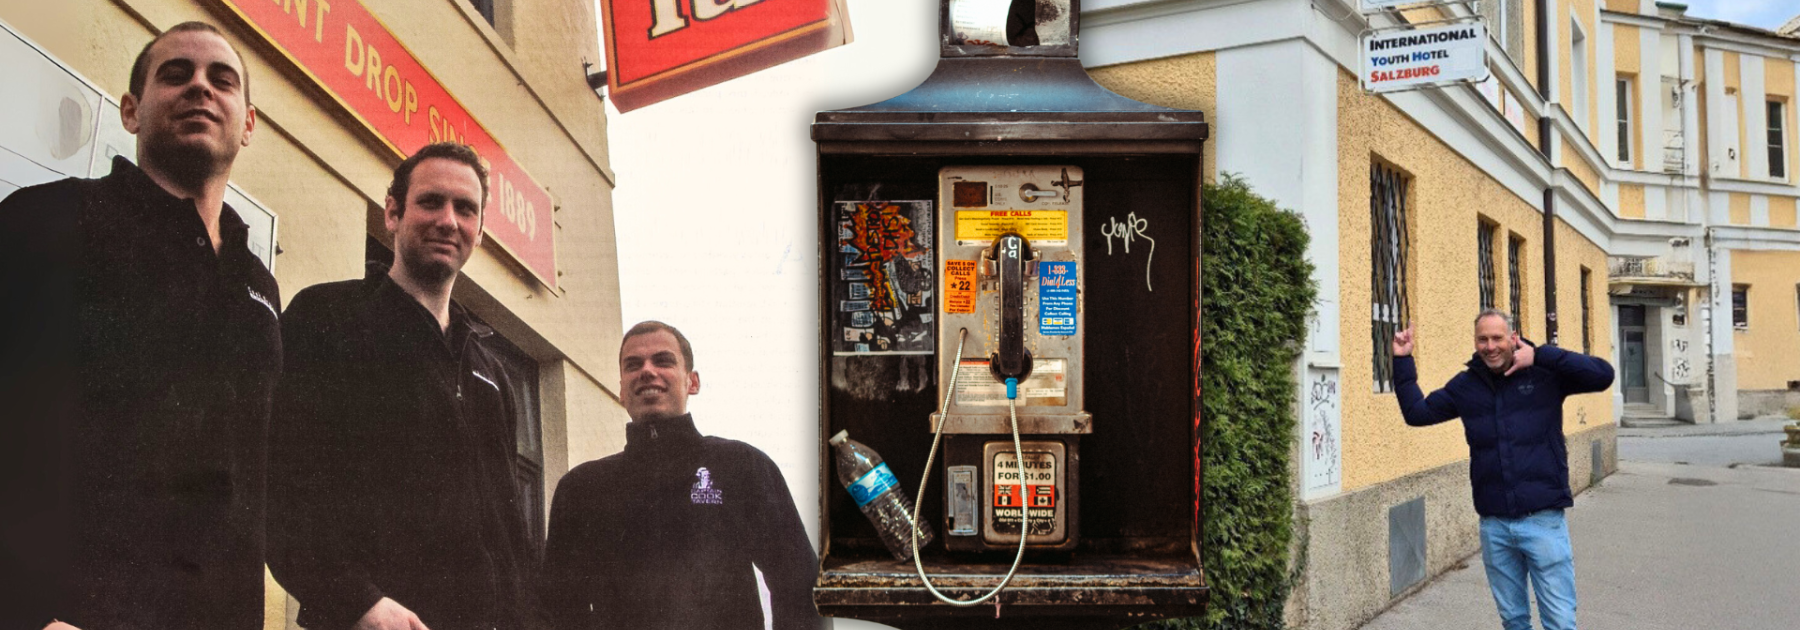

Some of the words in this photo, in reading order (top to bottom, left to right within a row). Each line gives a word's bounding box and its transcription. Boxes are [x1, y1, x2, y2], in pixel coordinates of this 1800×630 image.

[1369, 28, 1477, 51] INTERNATIONAL
[1370, 54, 1410, 66] YOUTH
[1412, 50, 1450, 62] HOTEL
[1370, 65, 1440, 83] SALZBURG
[344, 23, 418, 125] DROP
[498, 172, 536, 242] 1889
[997, 461, 1003, 469] 4
[1005, 461, 1052, 469] MIUTES
[998, 472, 1020, 480] FOR
